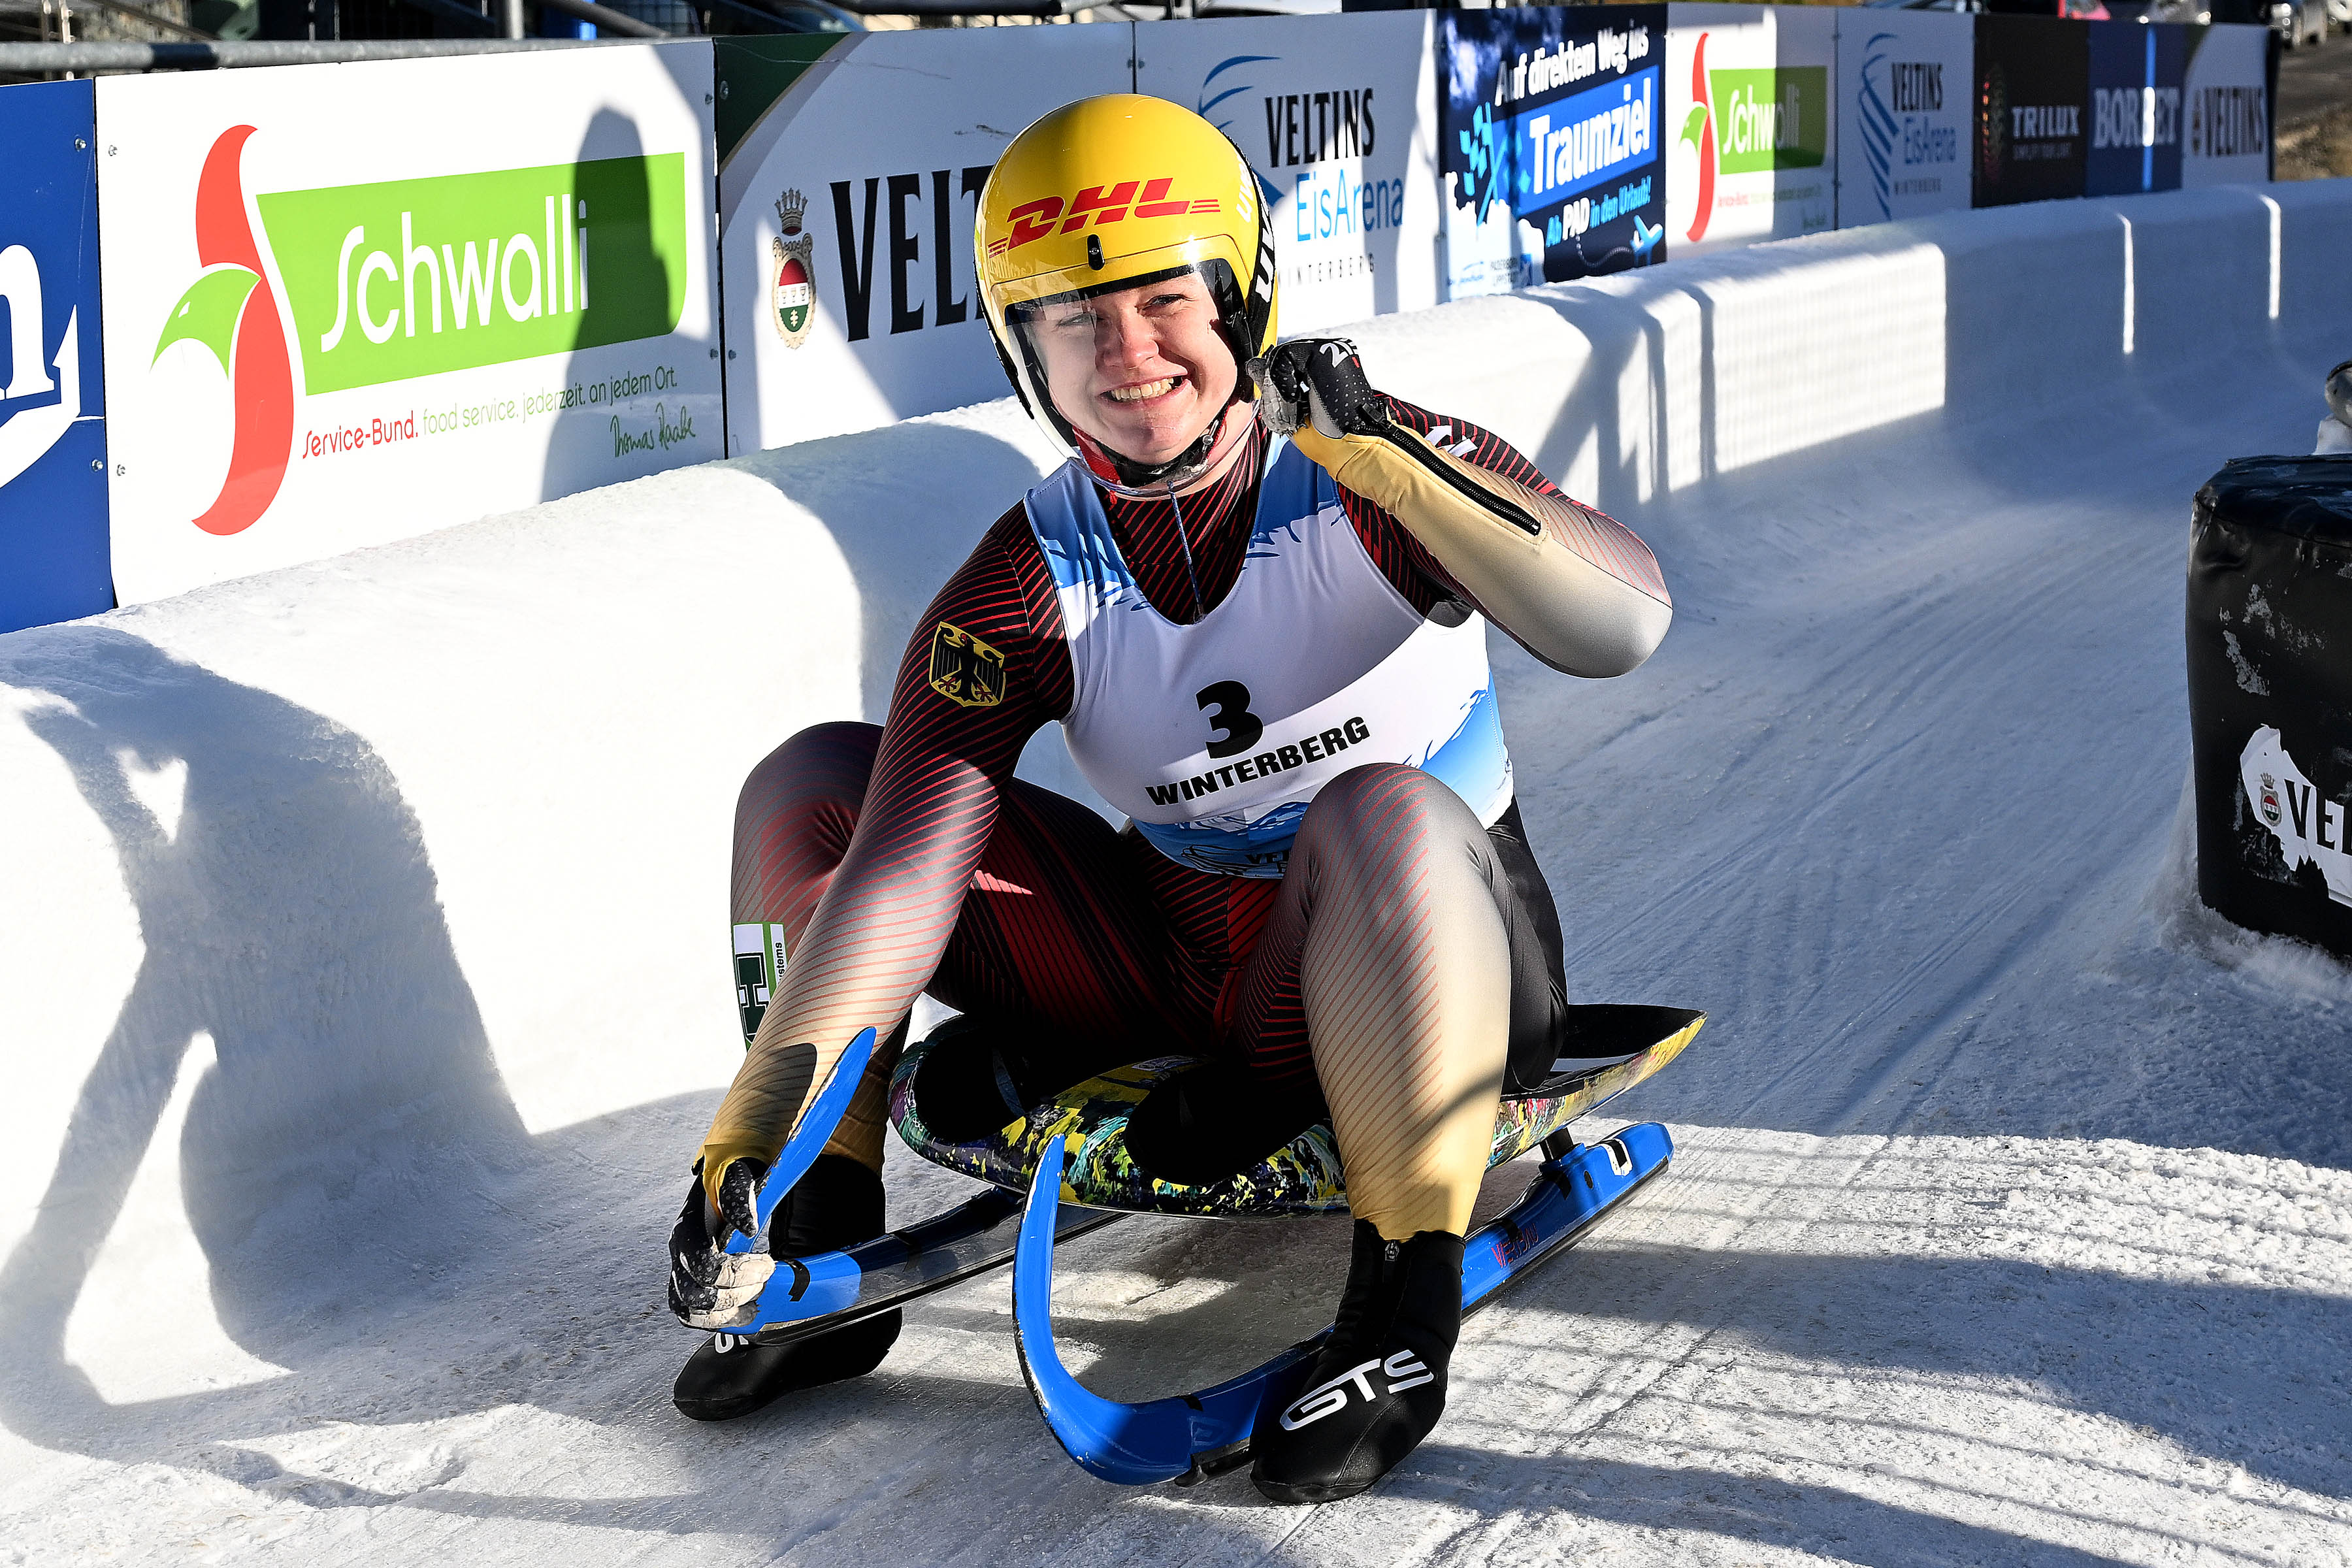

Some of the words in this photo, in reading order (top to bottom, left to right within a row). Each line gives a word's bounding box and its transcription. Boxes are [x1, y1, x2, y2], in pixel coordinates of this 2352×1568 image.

[1528, 40, 1595, 95] direktem
[1597, 26, 1627, 74] Weg
[1891, 62, 1943, 111] VELTINS
[1266, 88, 1375, 168] VELTINS
[1529, 76, 1651, 195] Traumziel
[1722, 84, 1800, 155] Schwalli
[2012, 105, 2080, 139] TRILUX
[1007, 177, 1191, 251] DHL
[1296, 169, 1403, 242] EisArena
[1562, 197, 1590, 241] PAD
[321, 193, 588, 353] Schwalli
[302, 410, 418, 459] Service-Bund.
[423, 402, 457, 435] food
[463, 397, 519, 427] service.
[589, 382, 606, 403] an
[610, 370, 651, 406] jedem
[655, 365, 678, 390] Ort.
[1195, 679, 1264, 760] 3
[1145, 716, 1371, 807] WINTERBERG
[1279, 1348, 1434, 1431] GTS
